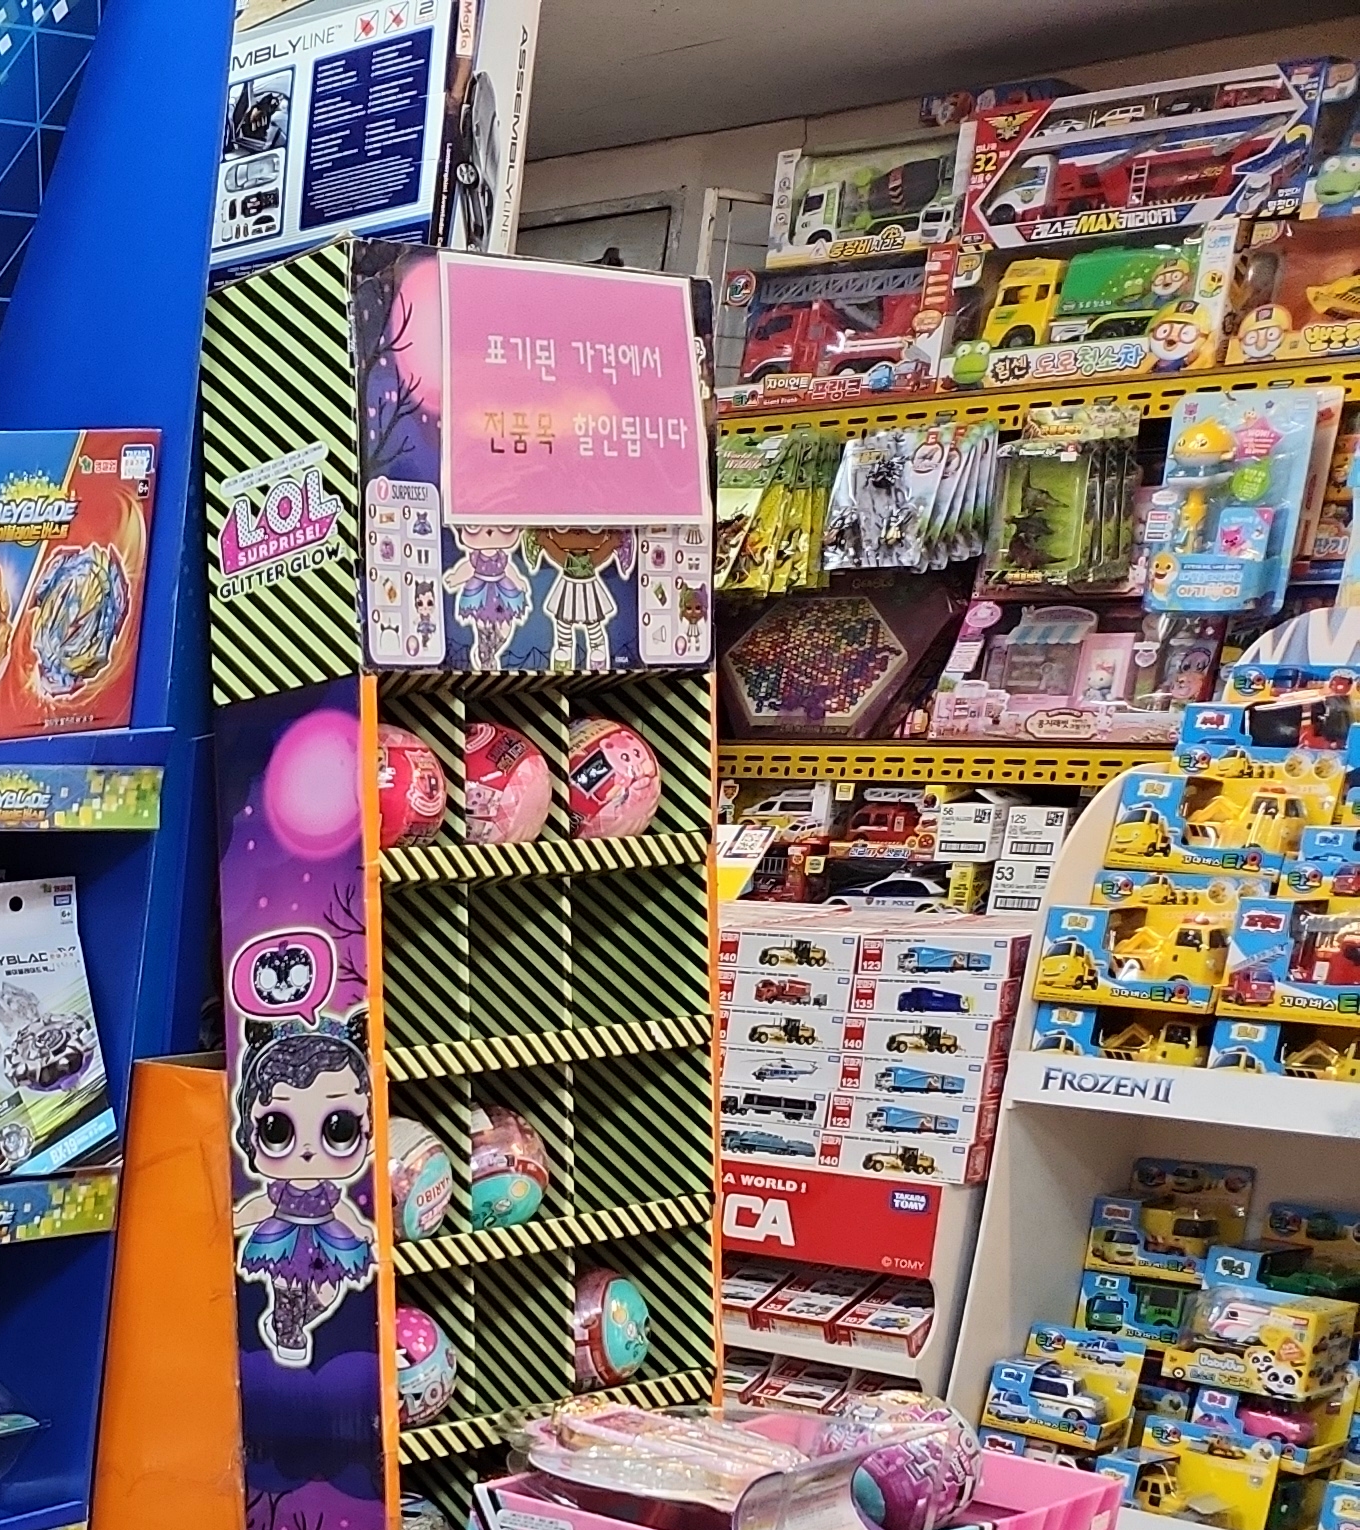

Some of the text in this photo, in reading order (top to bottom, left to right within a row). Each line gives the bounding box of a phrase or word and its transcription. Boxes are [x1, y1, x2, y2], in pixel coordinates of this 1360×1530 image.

[973, 152, 997, 172] 32
[1078, 211, 1122, 233] MAX
[485, 335, 663, 384] 표기된 가격에서
[994, 357, 1028, 381] 힘센
[483, 411, 688, 459] 전품목 할인됩니다
[391, 485, 429, 501] SURPRISES!
[237, 522, 322, 567] SURPRISE!
[219, 542, 342, 600] GLITTER GLOW
[942, 806, 954, 816] 56
[1010, 813, 1028, 824] 125
[1222, 851, 1261, 871] 타요
[995, 865, 1015, 881] 53
[862, 960, 882, 971] 123
[1149, 984, 1189, 1003] 타요
[855, 998, 874, 1009] 135
[1282, 994, 1336, 1011] 꼬마버스
[843, 1038, 863, 1049] 140
[841, 1077, 860, 1088] 123
[1041, 1066, 1175, 1104] FROZEN II
[832, 1116, 850, 1127] 123
[819, 1154, 839, 1166] 140
[894, 1190, 926, 1201] TAKARA
[893, 1199, 927, 1212] TOMY
[893, 1257, 925, 1271] TOMY
